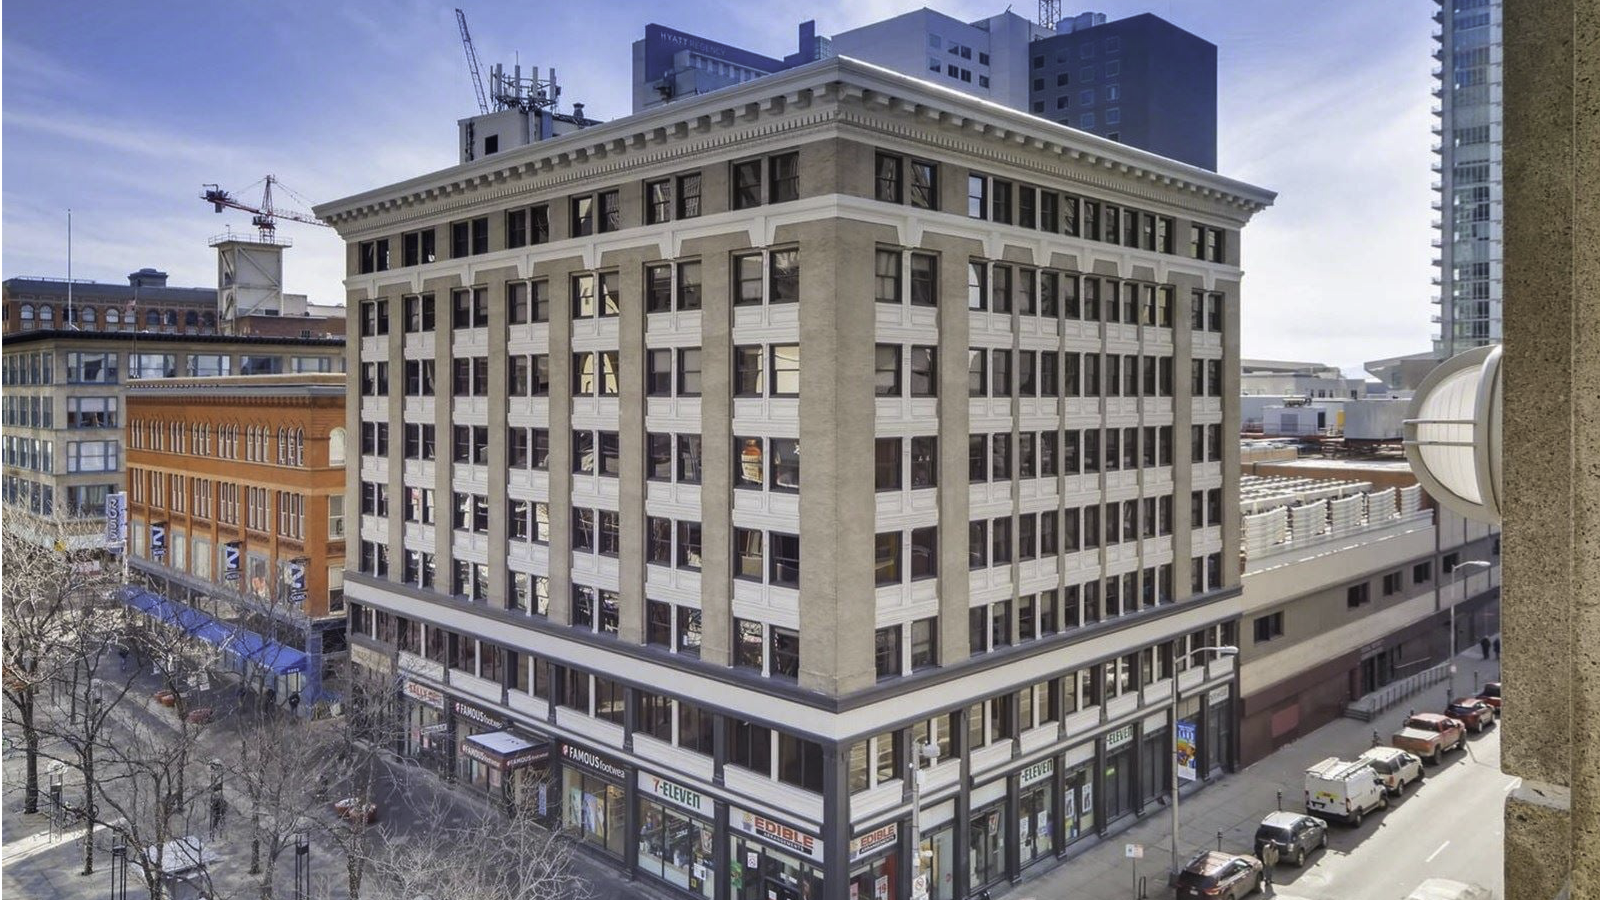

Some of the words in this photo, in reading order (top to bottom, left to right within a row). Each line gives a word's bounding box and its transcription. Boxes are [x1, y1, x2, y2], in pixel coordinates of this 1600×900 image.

[661, 32, 687, 45] HYATT
[569, 746, 600, 769] FAMOUS
[600, 760, 625, 779] footwea
[754, 816, 814, 850] EDIBLE
[861, 825, 895, 847] EDIBLE
